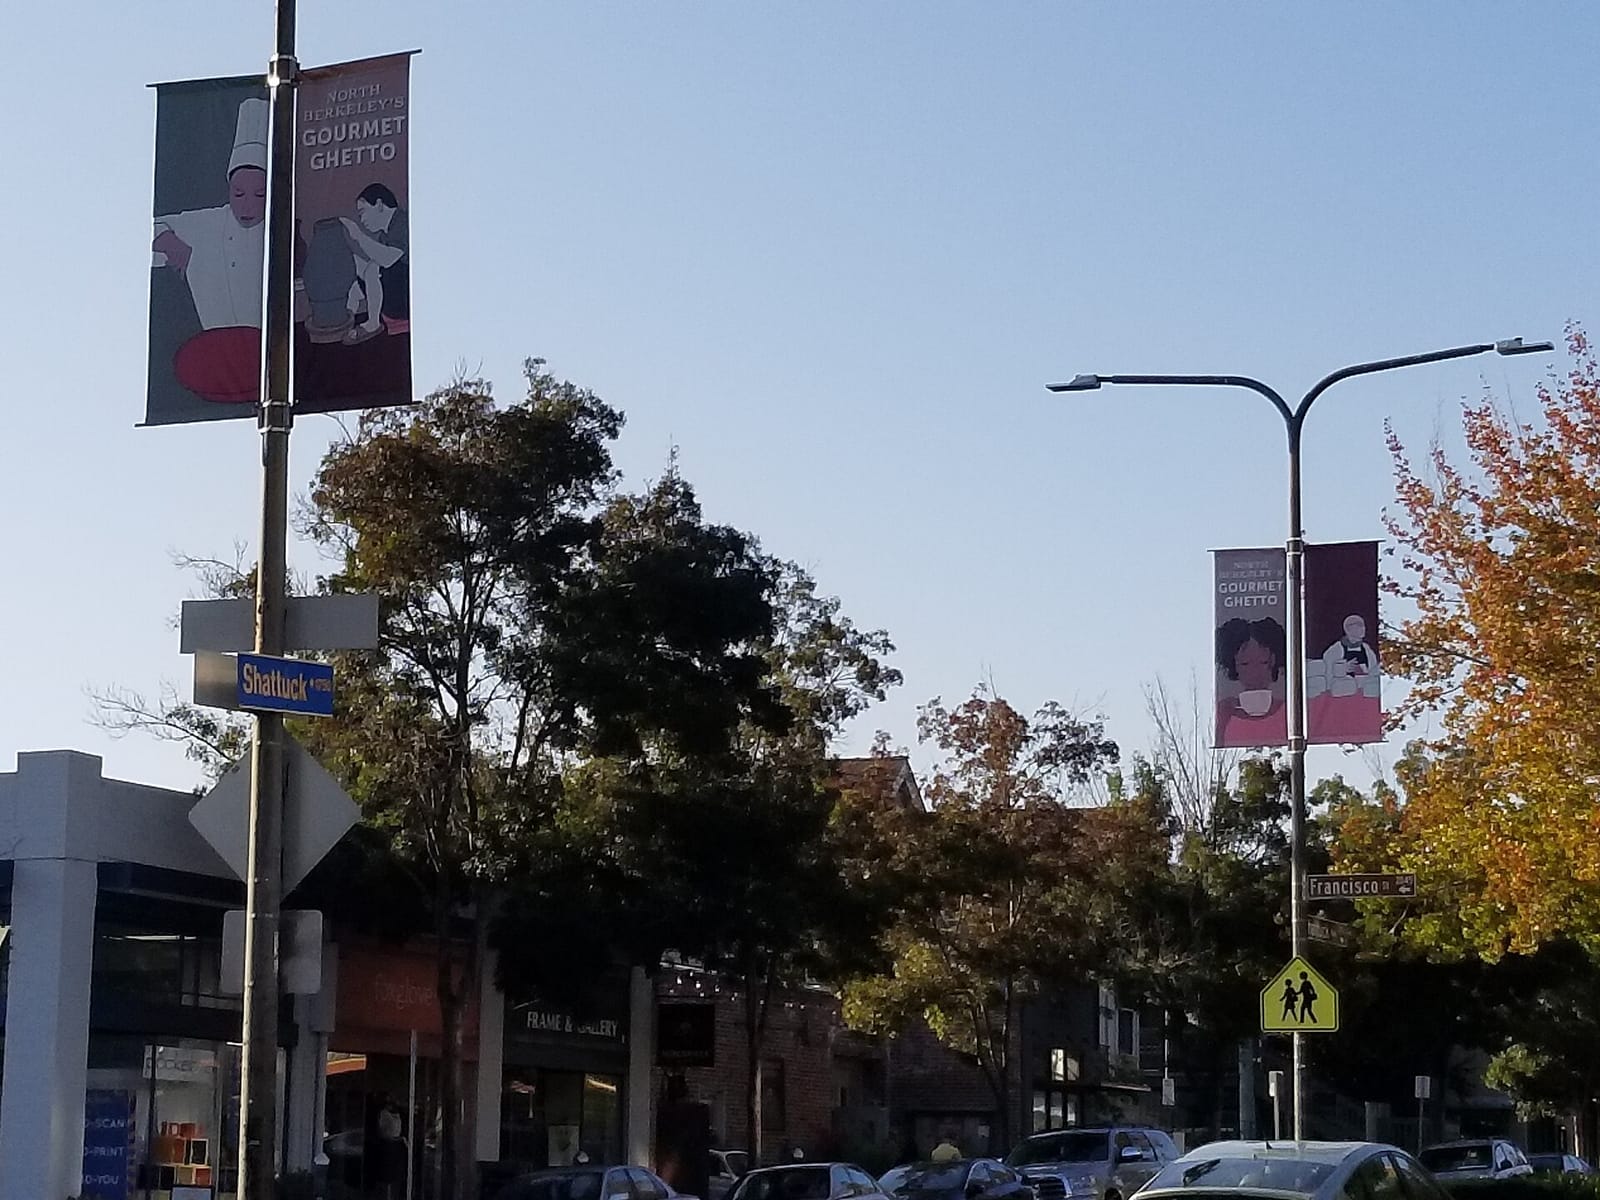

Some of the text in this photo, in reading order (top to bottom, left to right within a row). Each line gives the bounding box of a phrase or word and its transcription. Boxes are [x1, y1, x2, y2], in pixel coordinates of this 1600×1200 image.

[327, 84, 381, 103] NORTH
[303, 96, 406, 122] BERKELEY'S
[302, 116, 406, 146] GOURMET
[310, 142, 396, 170] GHETTO
[1219, 580, 1284, 593] GOURMET
[1224, 595, 1278, 607] GHETTO
[242, 663, 308, 701] Shattuck
[1310, 878, 1379, 895] Francisco
[527, 1011, 562, 1032] FRAME
[564, 1016, 573, 1033] &
